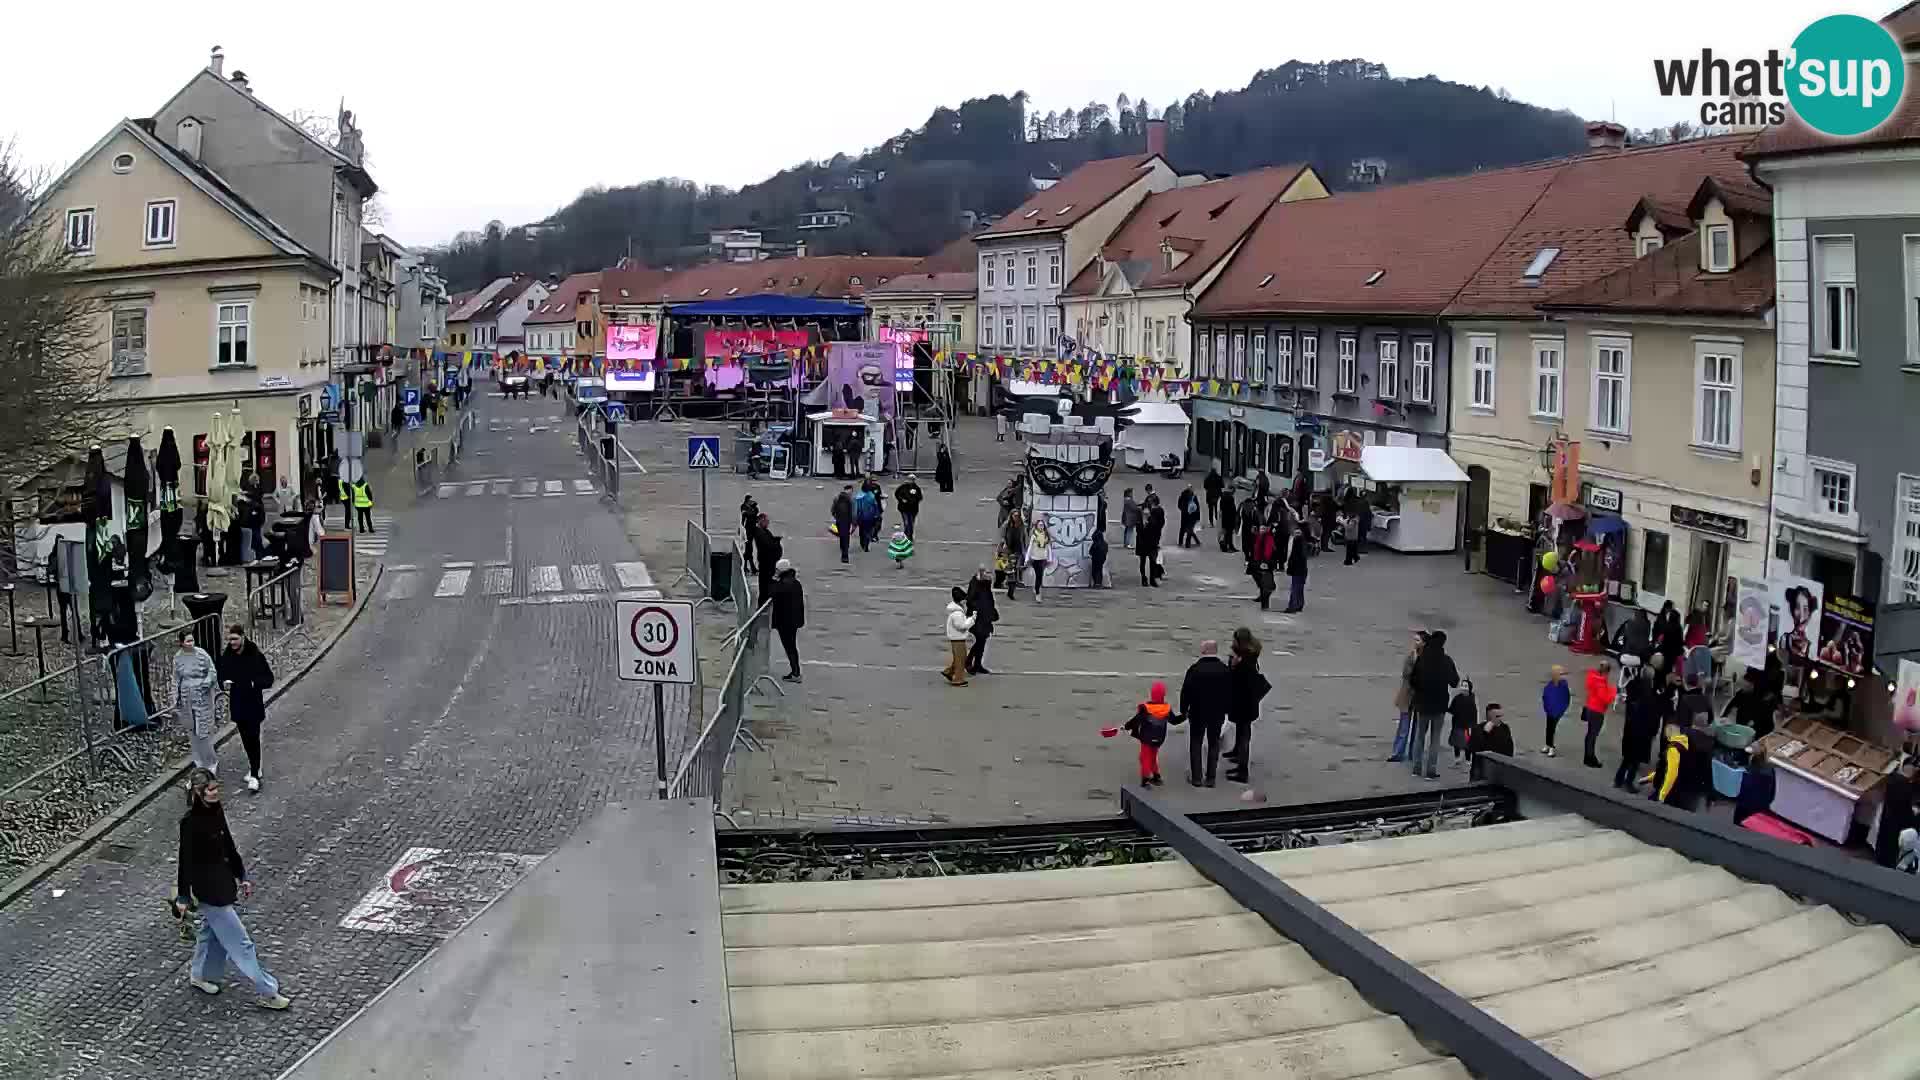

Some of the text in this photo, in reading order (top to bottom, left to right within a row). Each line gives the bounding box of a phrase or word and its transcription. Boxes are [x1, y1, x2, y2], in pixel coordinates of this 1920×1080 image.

[407, 391, 416, 402] P
[643, 622, 667, 643] 30
[633, 660, 678, 677] ZONA
